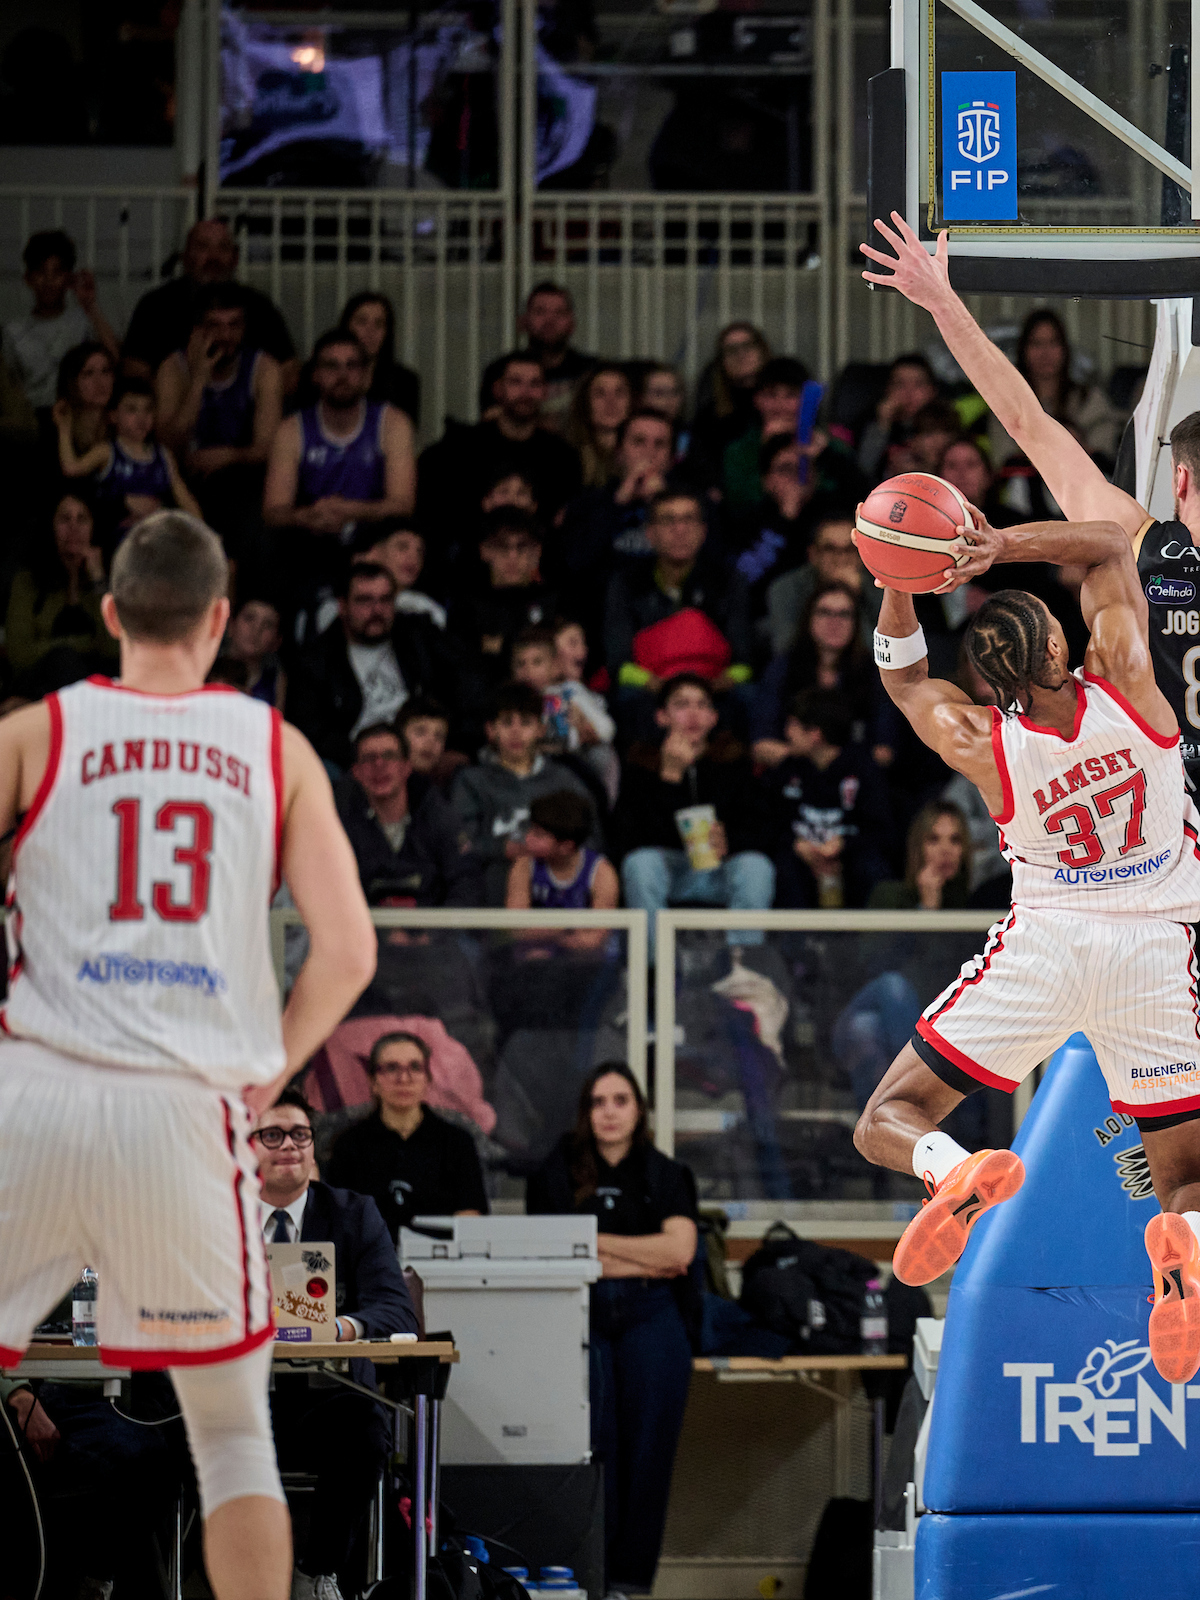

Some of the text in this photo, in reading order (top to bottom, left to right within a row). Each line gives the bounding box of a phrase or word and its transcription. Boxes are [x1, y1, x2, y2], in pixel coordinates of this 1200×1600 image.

[951, 170, 1009, 191] FIP
[1148, 585, 1193, 598] Melinda
[80, 738, 252, 797] CANDUSSI
[1032, 748, 1137, 816] RAMSEY
[1043, 767, 1148, 870] 37
[109, 797, 215, 924] 13
[1130, 1061, 1198, 1079] BLUENERGY
[1093, 1112, 1136, 1148] AQU
